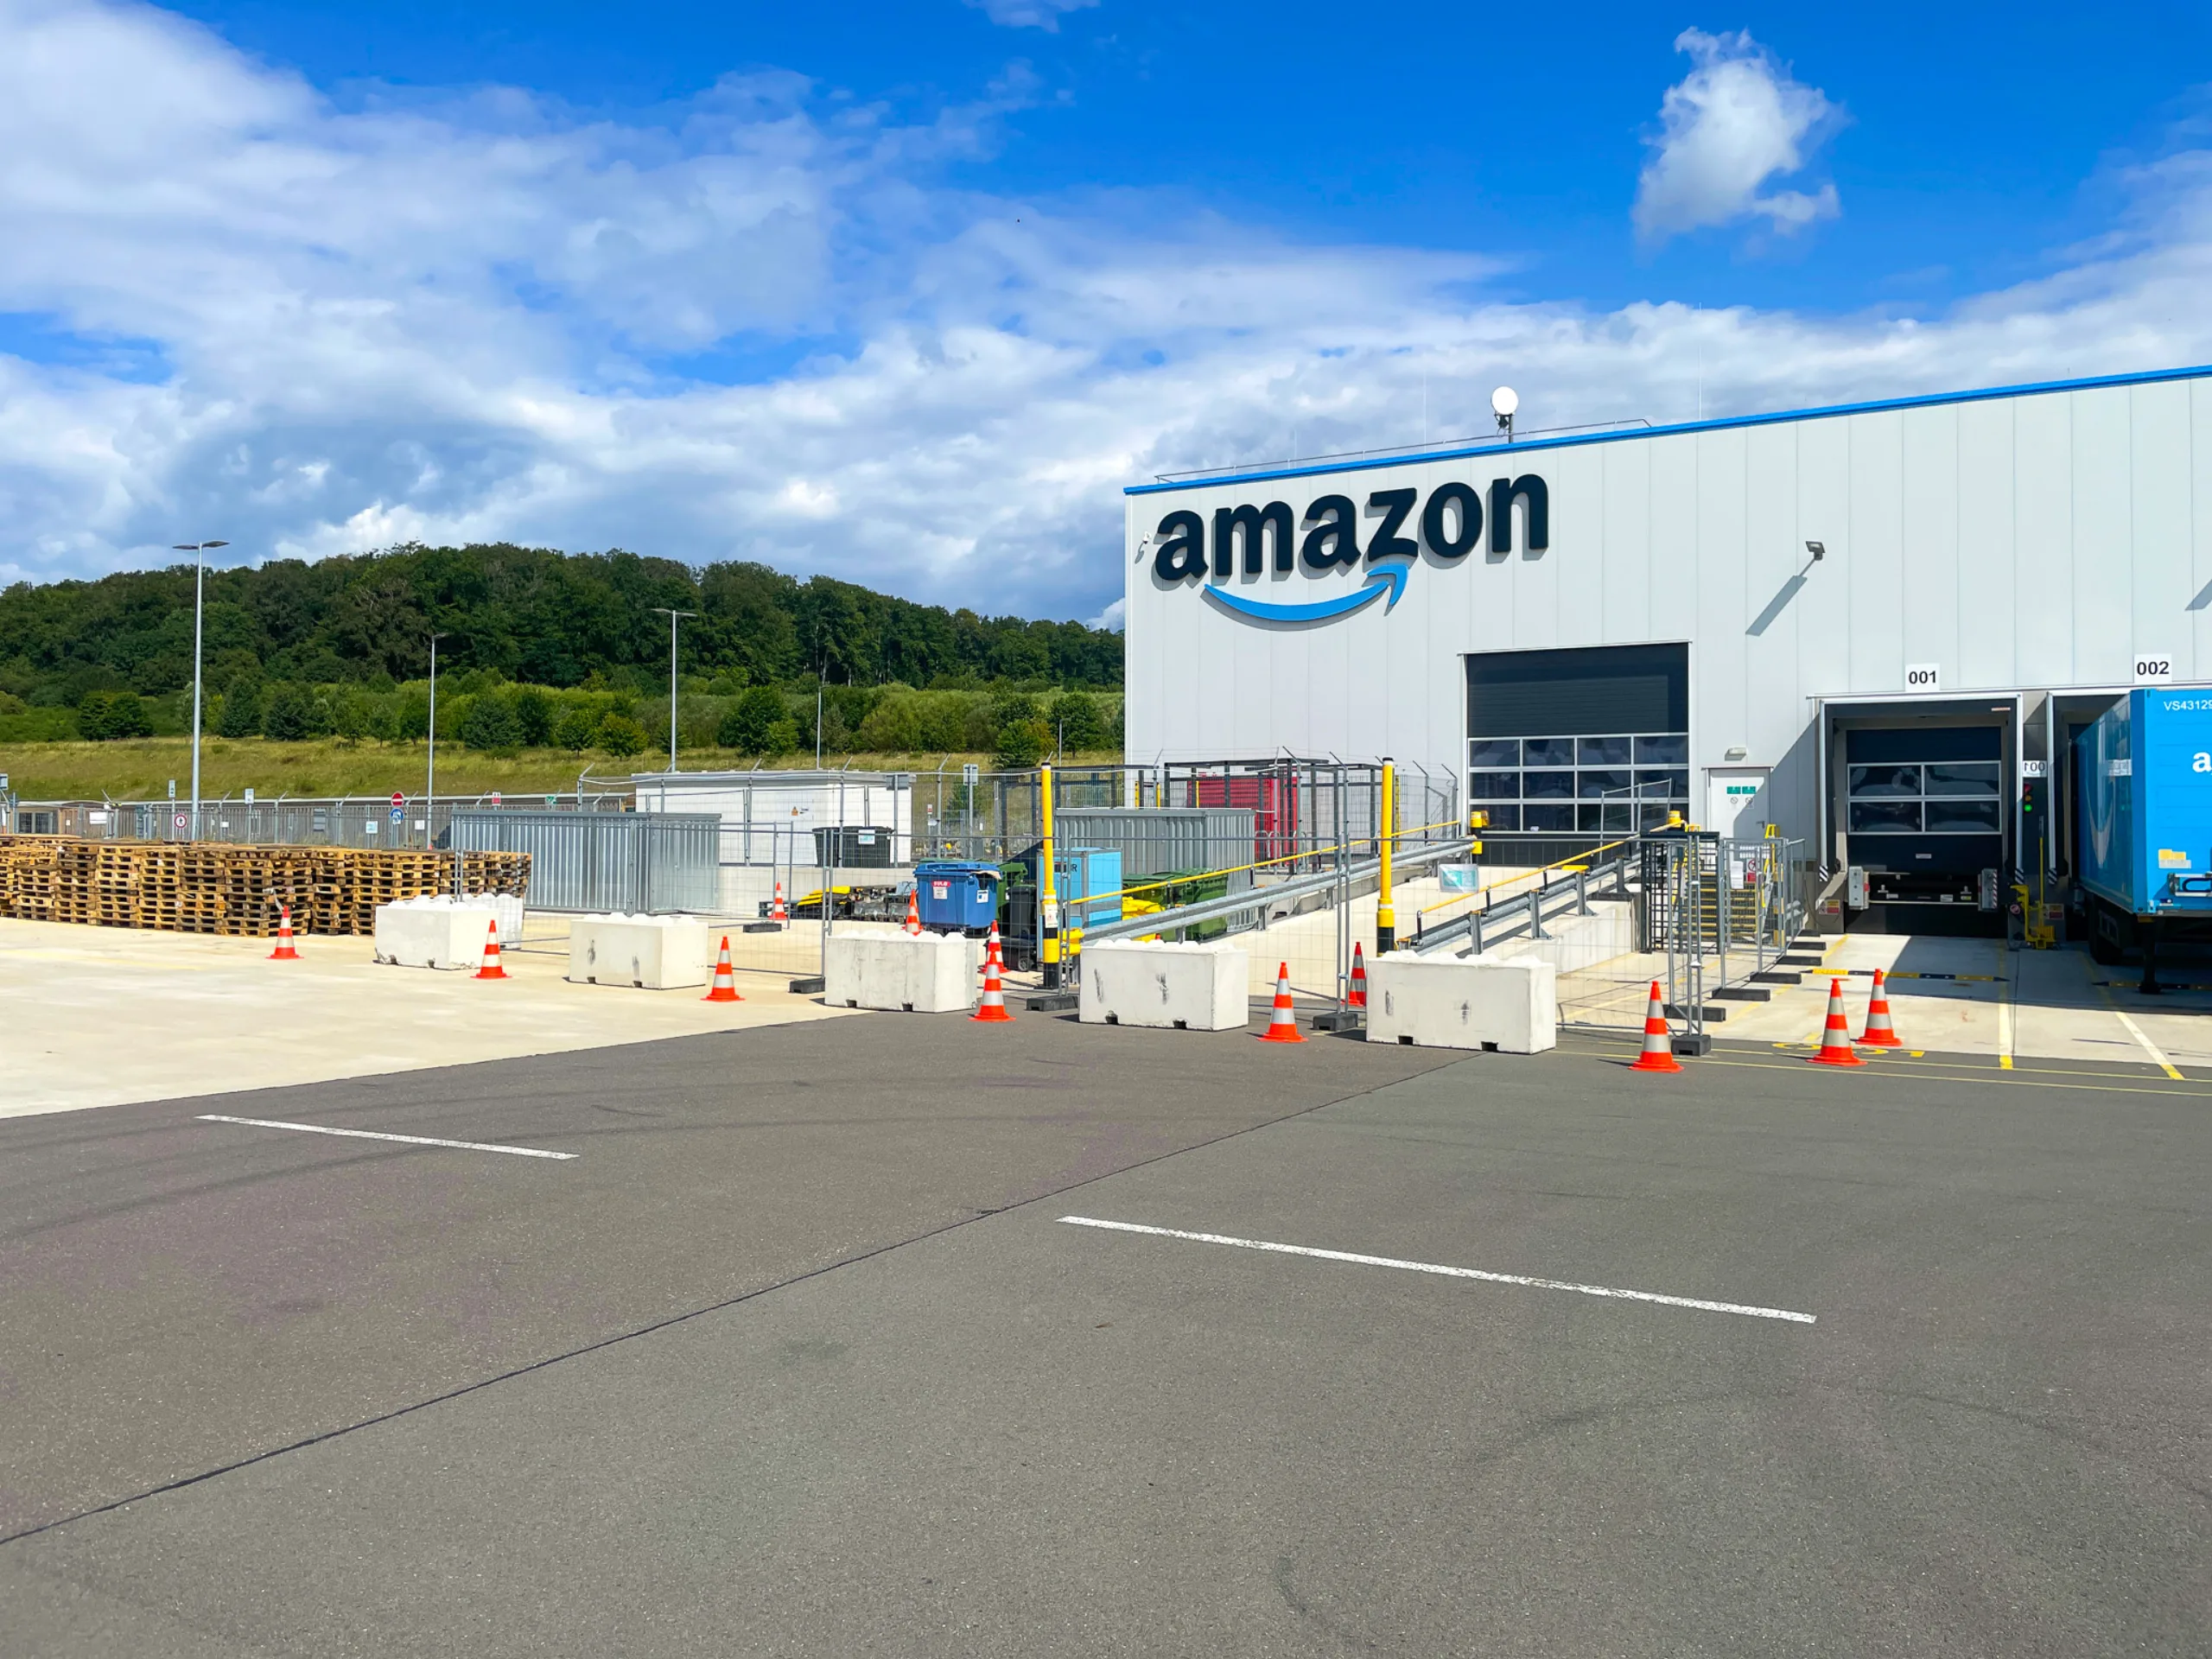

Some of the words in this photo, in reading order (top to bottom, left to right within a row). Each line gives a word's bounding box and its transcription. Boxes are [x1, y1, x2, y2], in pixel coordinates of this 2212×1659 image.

[1154, 474, 1549, 582] amazon
[2137, 661, 2170, 675] 002
[1909, 671, 1936, 683] 001
